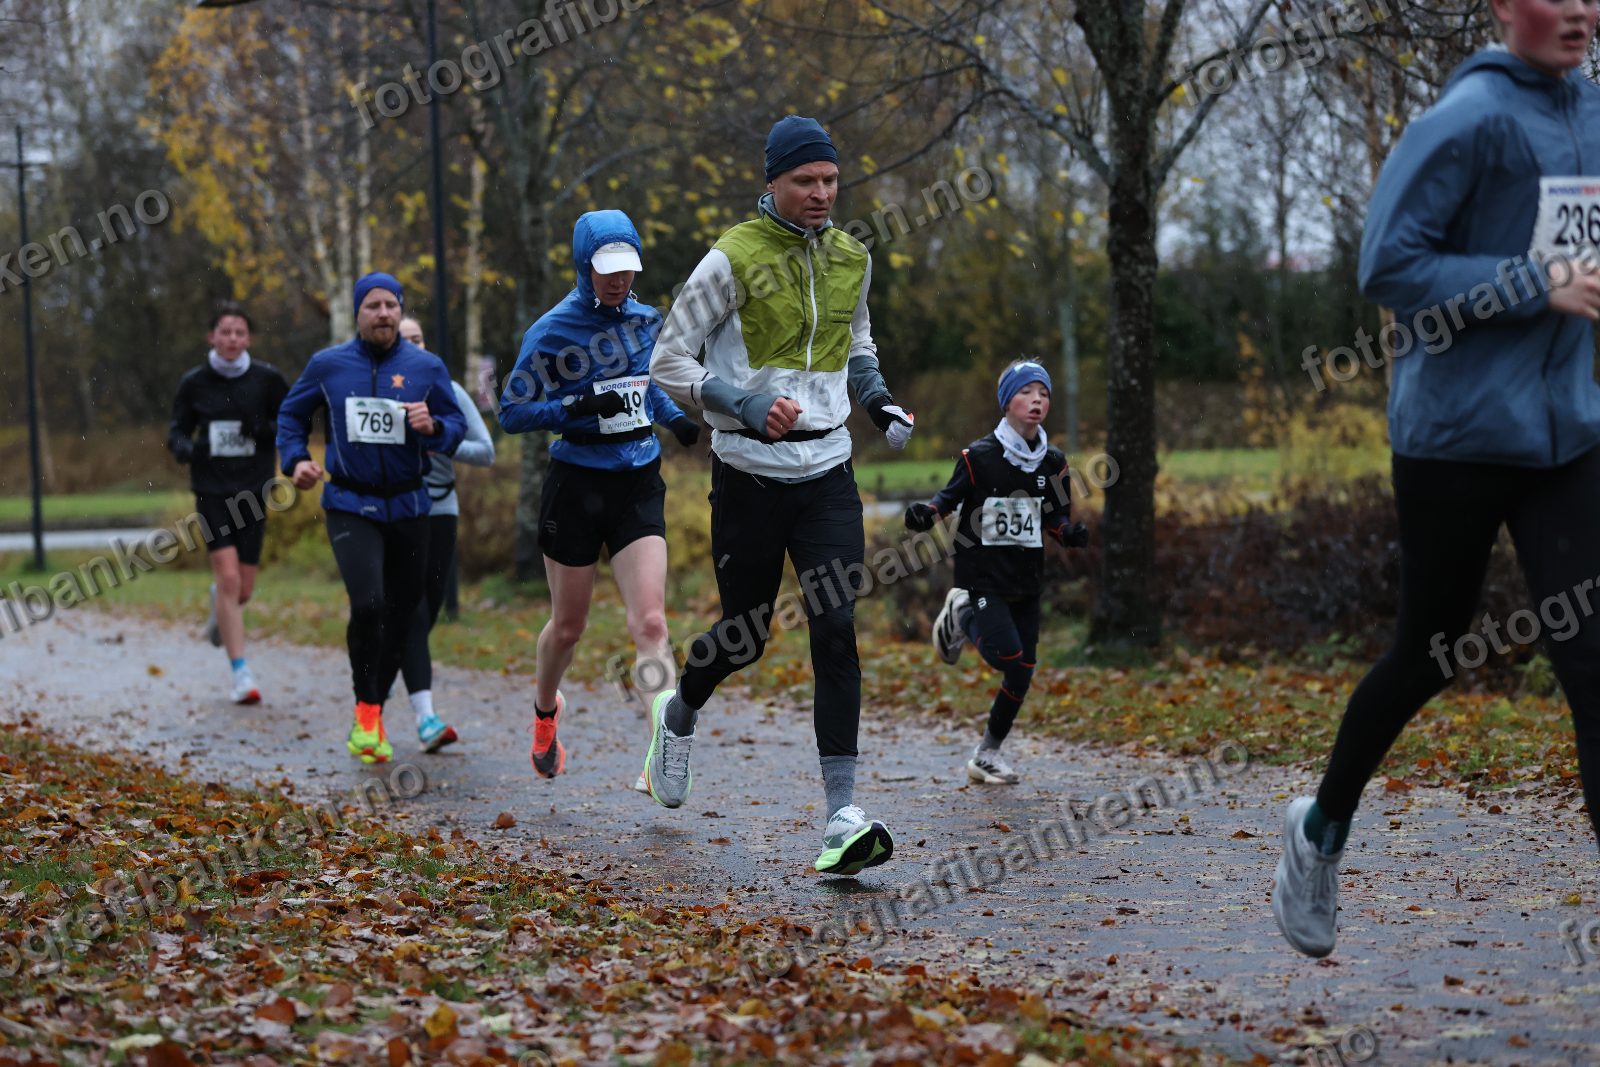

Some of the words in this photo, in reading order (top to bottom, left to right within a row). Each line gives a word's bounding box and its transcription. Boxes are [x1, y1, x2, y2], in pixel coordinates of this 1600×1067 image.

[1553, 204, 1600, 246] 236
[357, 411, 393, 433] 769
[996, 513, 1033, 536] 654
